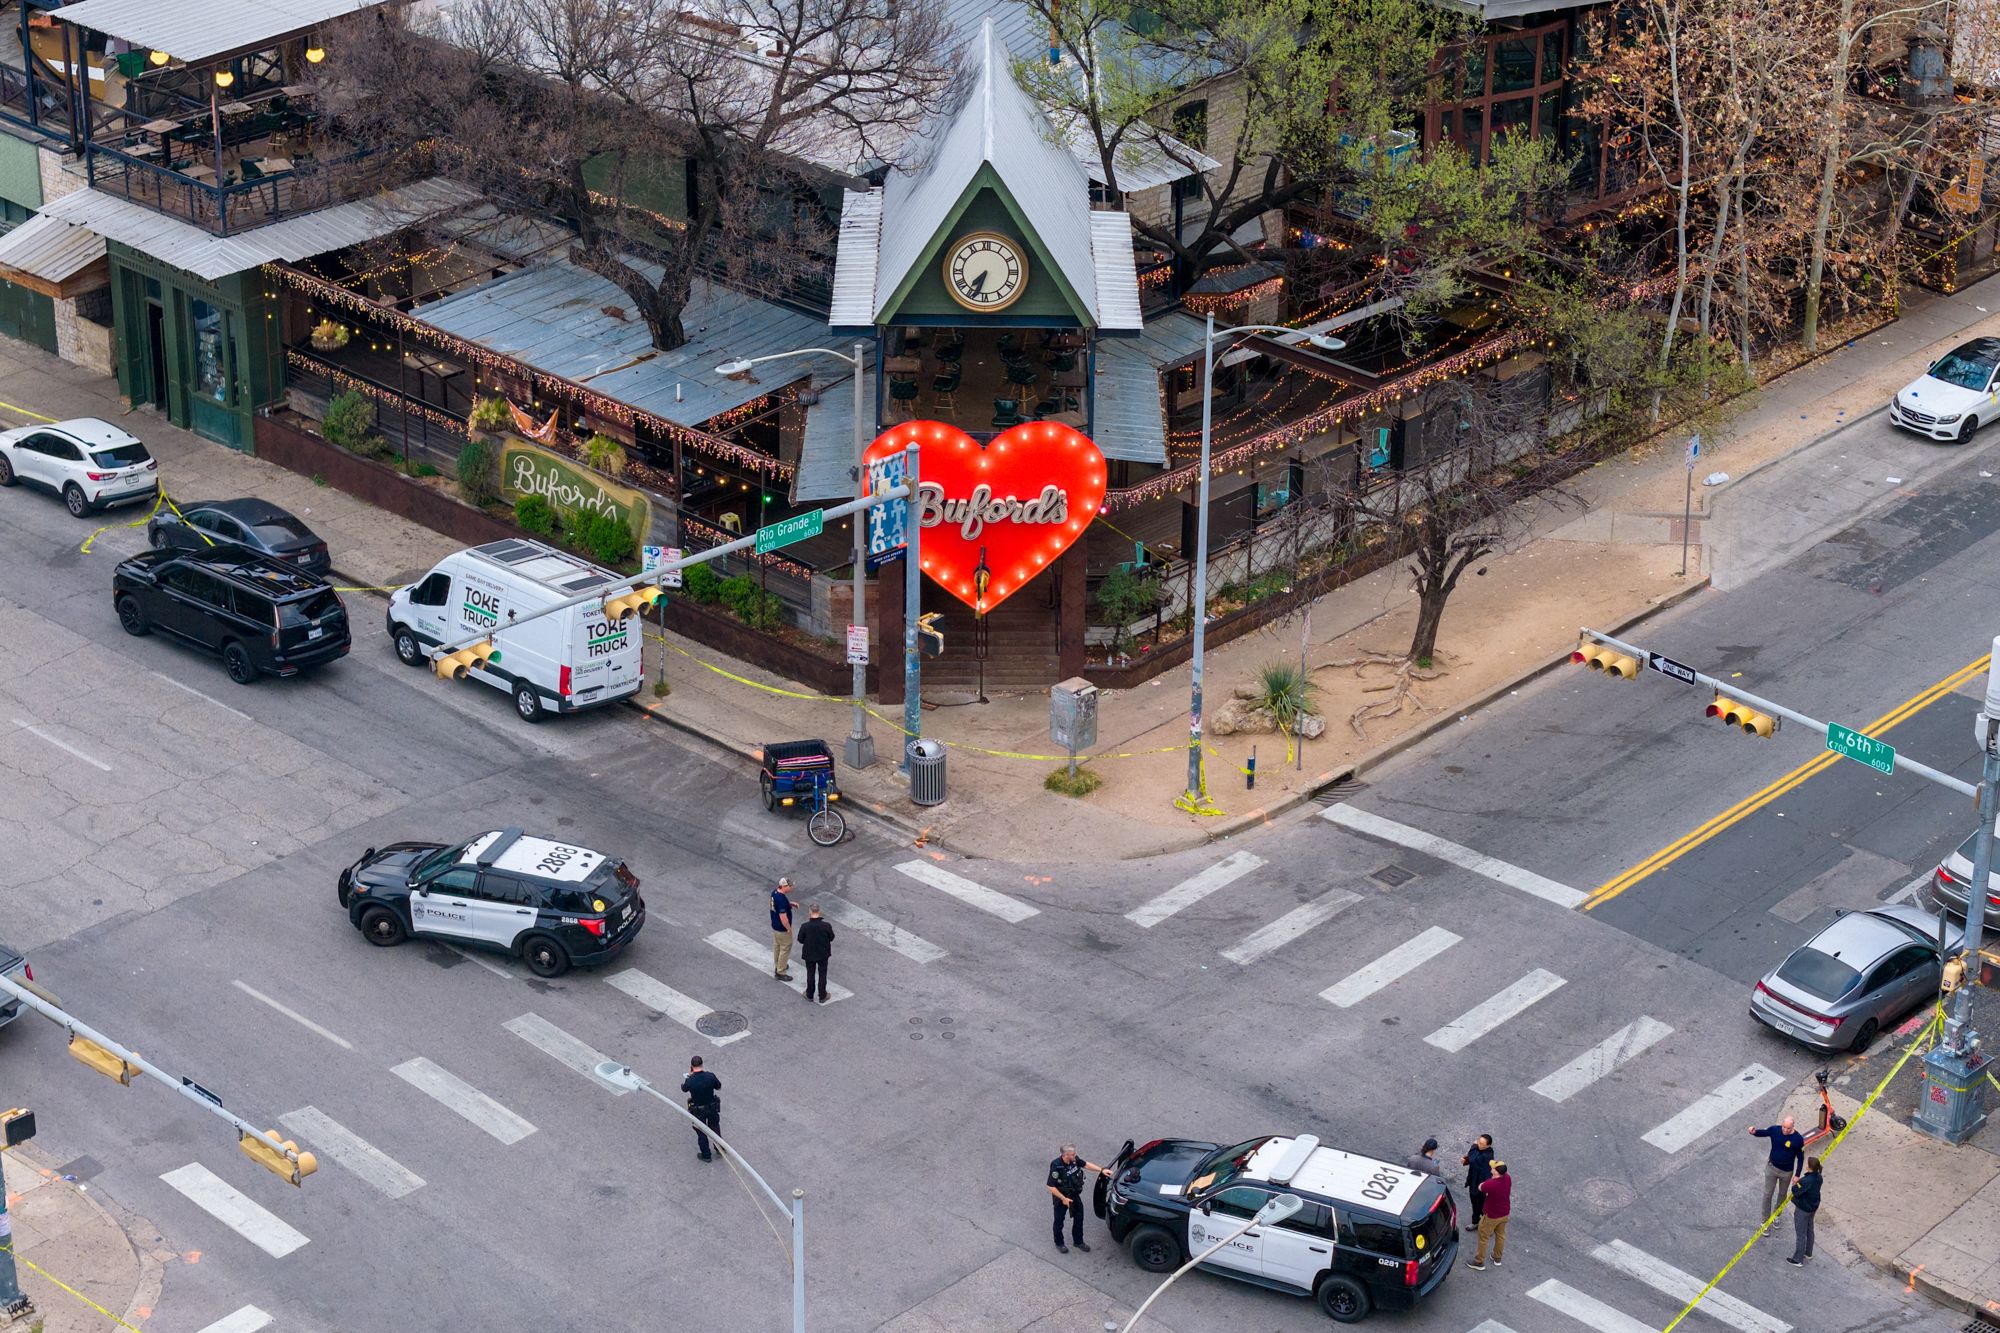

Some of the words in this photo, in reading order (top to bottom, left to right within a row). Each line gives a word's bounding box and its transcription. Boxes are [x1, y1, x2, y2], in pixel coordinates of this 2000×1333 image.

[918, 481, 1068, 540] Buford's
[760, 528, 774, 542] Rio
[777, 517, 809, 537] Grande
[812, 511, 820, 521] ST
[804, 527, 816, 537] 600
[764, 540, 776, 551] 500
[486, 579, 504, 593] DELIVERY
[465, 586, 500, 614] TOKE
[463, 608, 498, 629] TRUCK
[586, 617, 627, 640] TOKE
[588, 636, 628, 657] TRUCK
[1662, 661, 1676, 672] ONE
[1677, 668, 1691, 678] WAY
[1834, 741, 1848, 754] 700
[1838, 730, 1846, 740] W
[1846, 732, 1872, 755] 6th
[1875, 742, 1886, 754] ST
[1871, 758, 1886, 770] 600
[536, 846, 578, 874] 2868
[427, 909, 466, 921] POLICE
[561, 916, 578, 924] 2868
[617, 910, 637, 933] POLICE
[1361, 1166, 1405, 1201] 0281
[1207, 1234, 1255, 1252] POICE
[1378, 1258, 1399, 1268] 0281
